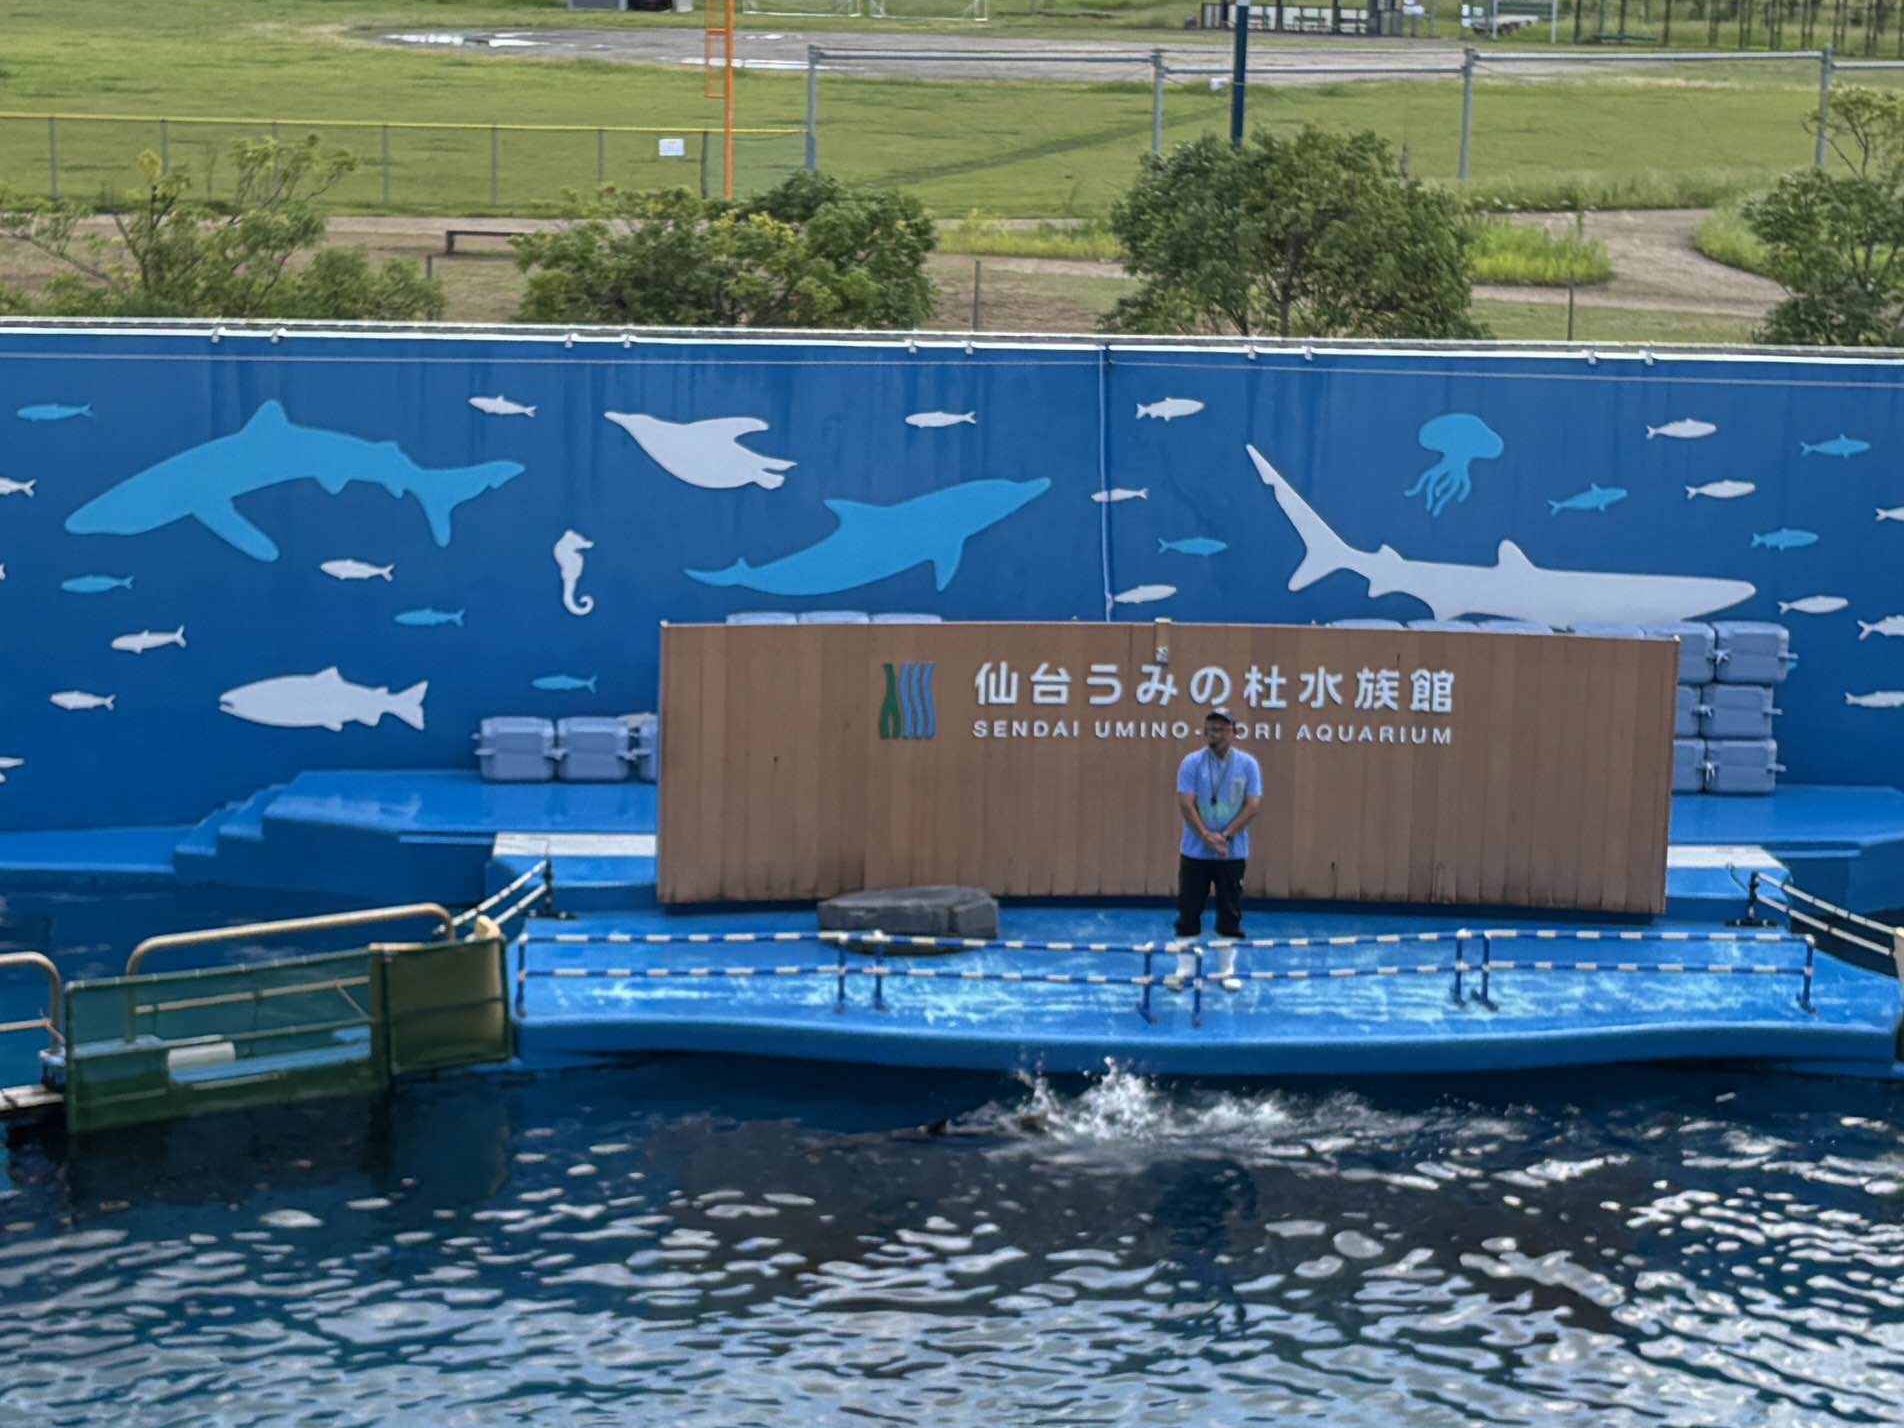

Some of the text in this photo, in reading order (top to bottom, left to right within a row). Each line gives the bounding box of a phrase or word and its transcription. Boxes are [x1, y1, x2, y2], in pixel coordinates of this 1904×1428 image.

[974, 661, 1456, 713] 仙台うみの杜水族館
[973, 720, 1453, 746] SENDAI UMINO-ORI AQUARIUM
